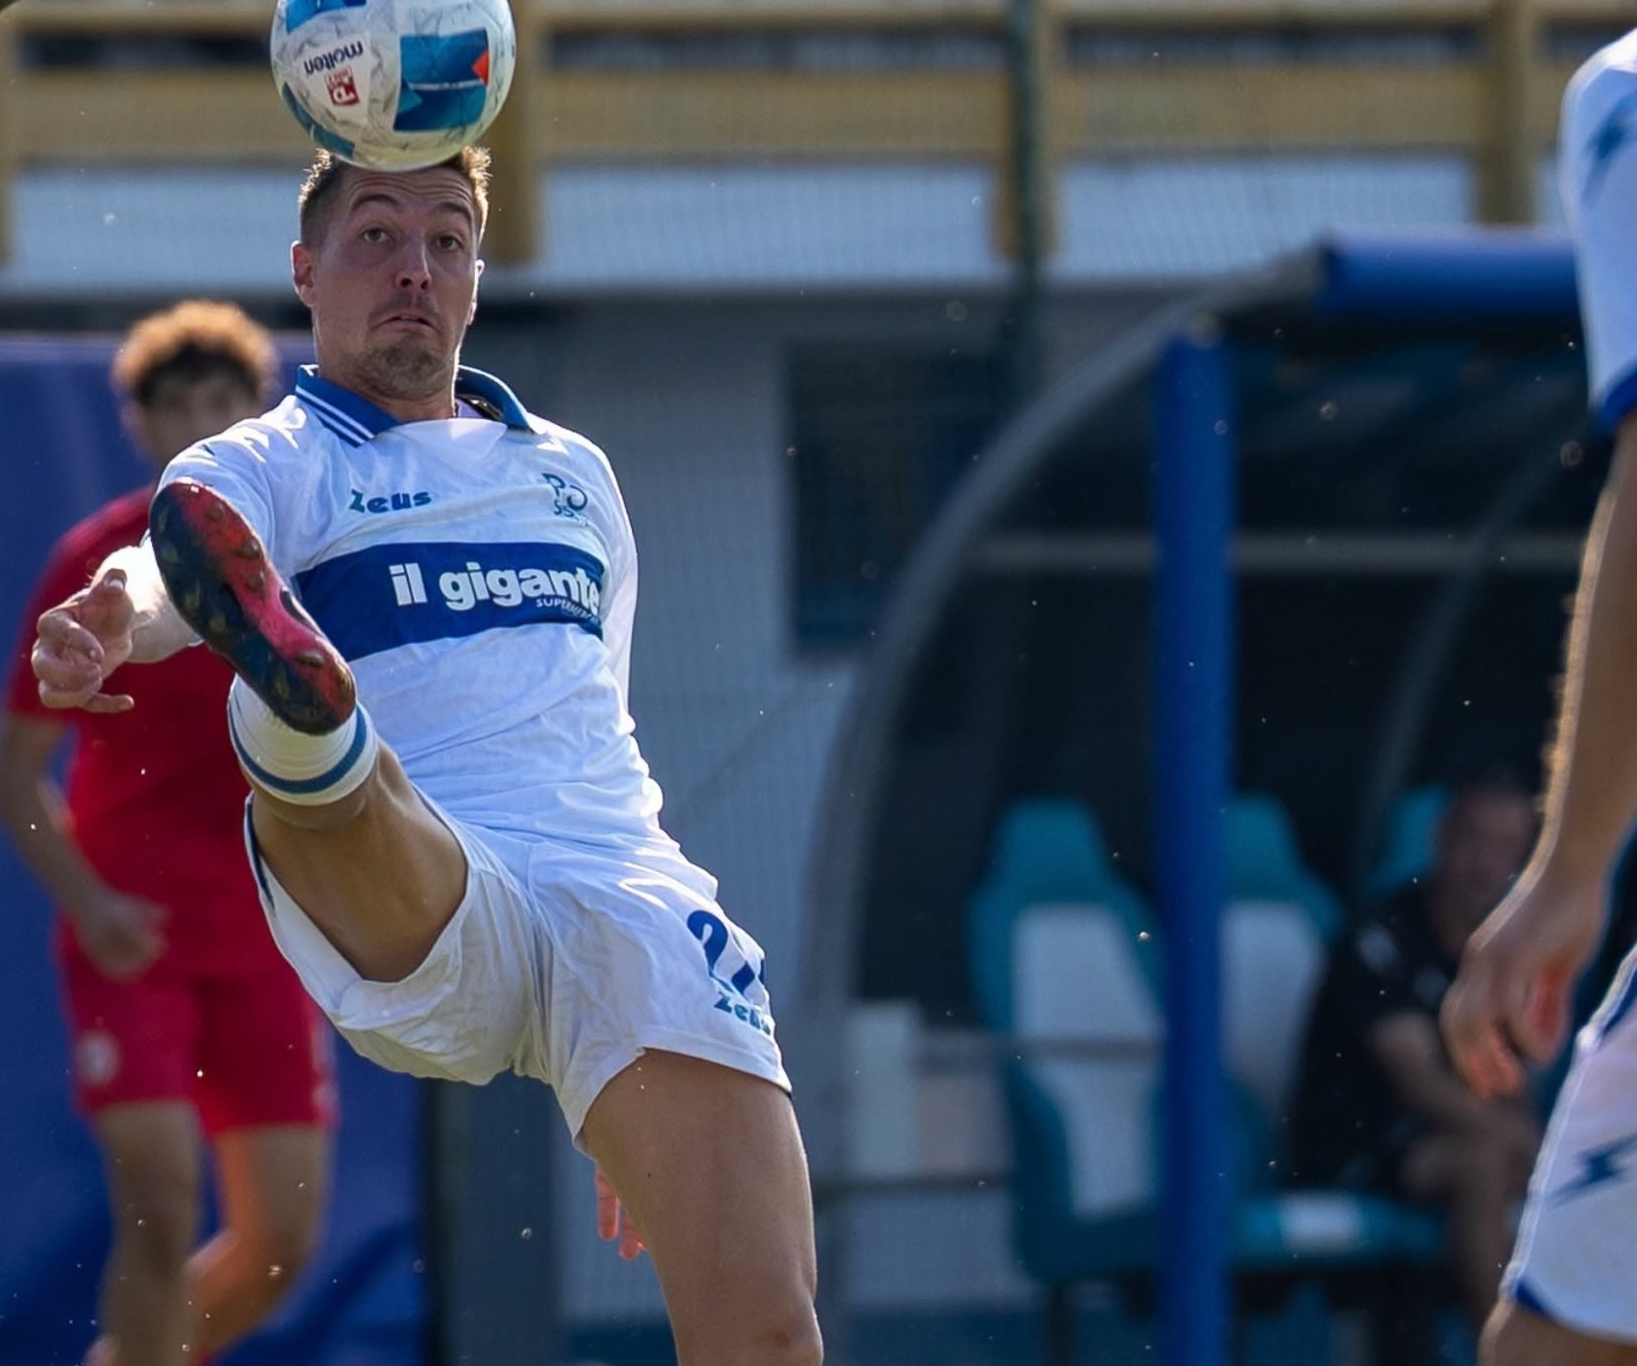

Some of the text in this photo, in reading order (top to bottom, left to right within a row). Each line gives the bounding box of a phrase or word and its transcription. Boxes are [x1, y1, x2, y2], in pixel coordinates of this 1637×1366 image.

[303, 40, 364, 75] molten
[348, 488, 432, 514] Zeus
[388, 561, 600, 616] il gigante
